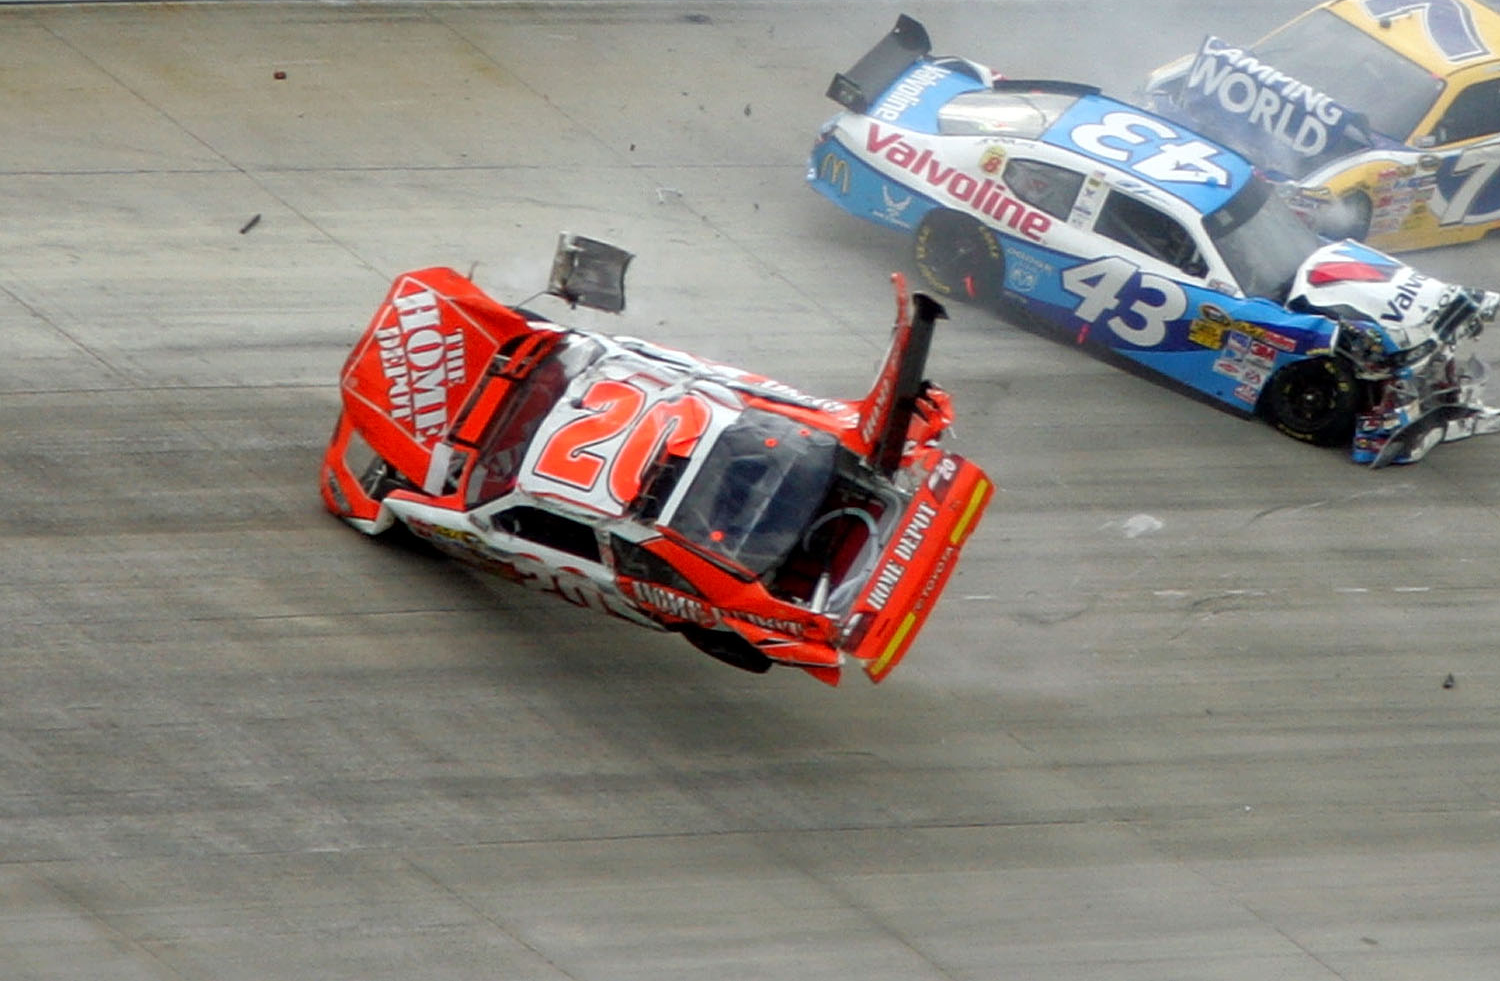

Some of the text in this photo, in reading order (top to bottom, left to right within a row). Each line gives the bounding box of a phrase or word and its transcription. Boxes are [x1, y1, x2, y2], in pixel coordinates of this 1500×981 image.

[1187, 55, 1328, 157] WORLD
[1203, 35, 1343, 127] CAMPING
[865, 122, 1052, 243] Valvoline
[1071, 111, 1229, 187] 43
[1062, 256, 1187, 347] 43
[375, 326, 413, 420] DEPOT
[393, 289, 450, 443] HOME
[444, 327, 467, 387] THE
[534, 378, 712, 504] 20
[866, 501, 937, 610] HOME DEPOT
